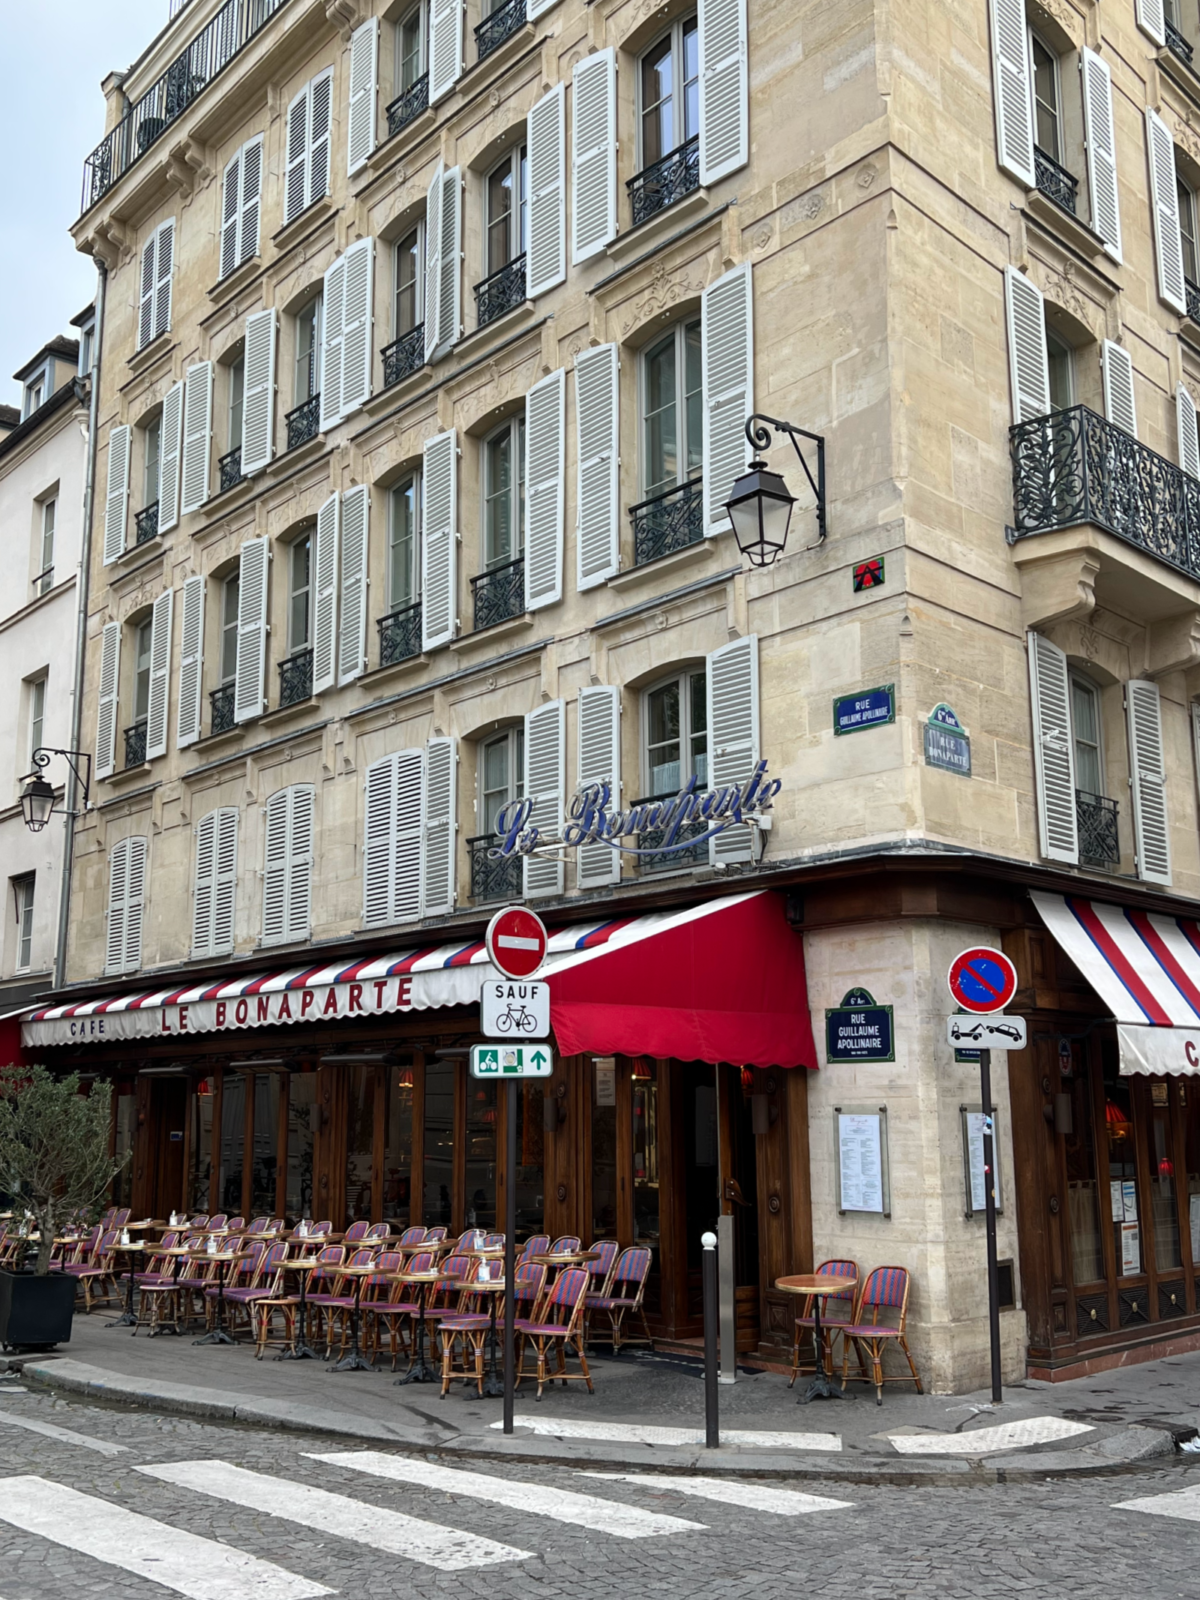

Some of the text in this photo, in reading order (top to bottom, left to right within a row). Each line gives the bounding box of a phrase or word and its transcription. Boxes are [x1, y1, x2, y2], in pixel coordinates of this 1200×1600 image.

[855, 699, 870, 711] RUE
[940, 736, 956, 750] RUE
[929, 746, 967, 766] BONAPARTE
[488, 759, 782, 859] Le Bonaparte
[495, 984, 539, 999] SAUF
[69, 977, 413, 1037] CAFE LE BONAPARTE
[851, 1013, 866, 1024] RUE
[838, 1025, 880, 1037] GUILLAUME
[837, 1038, 882, 1049] APOLLINAIRE
